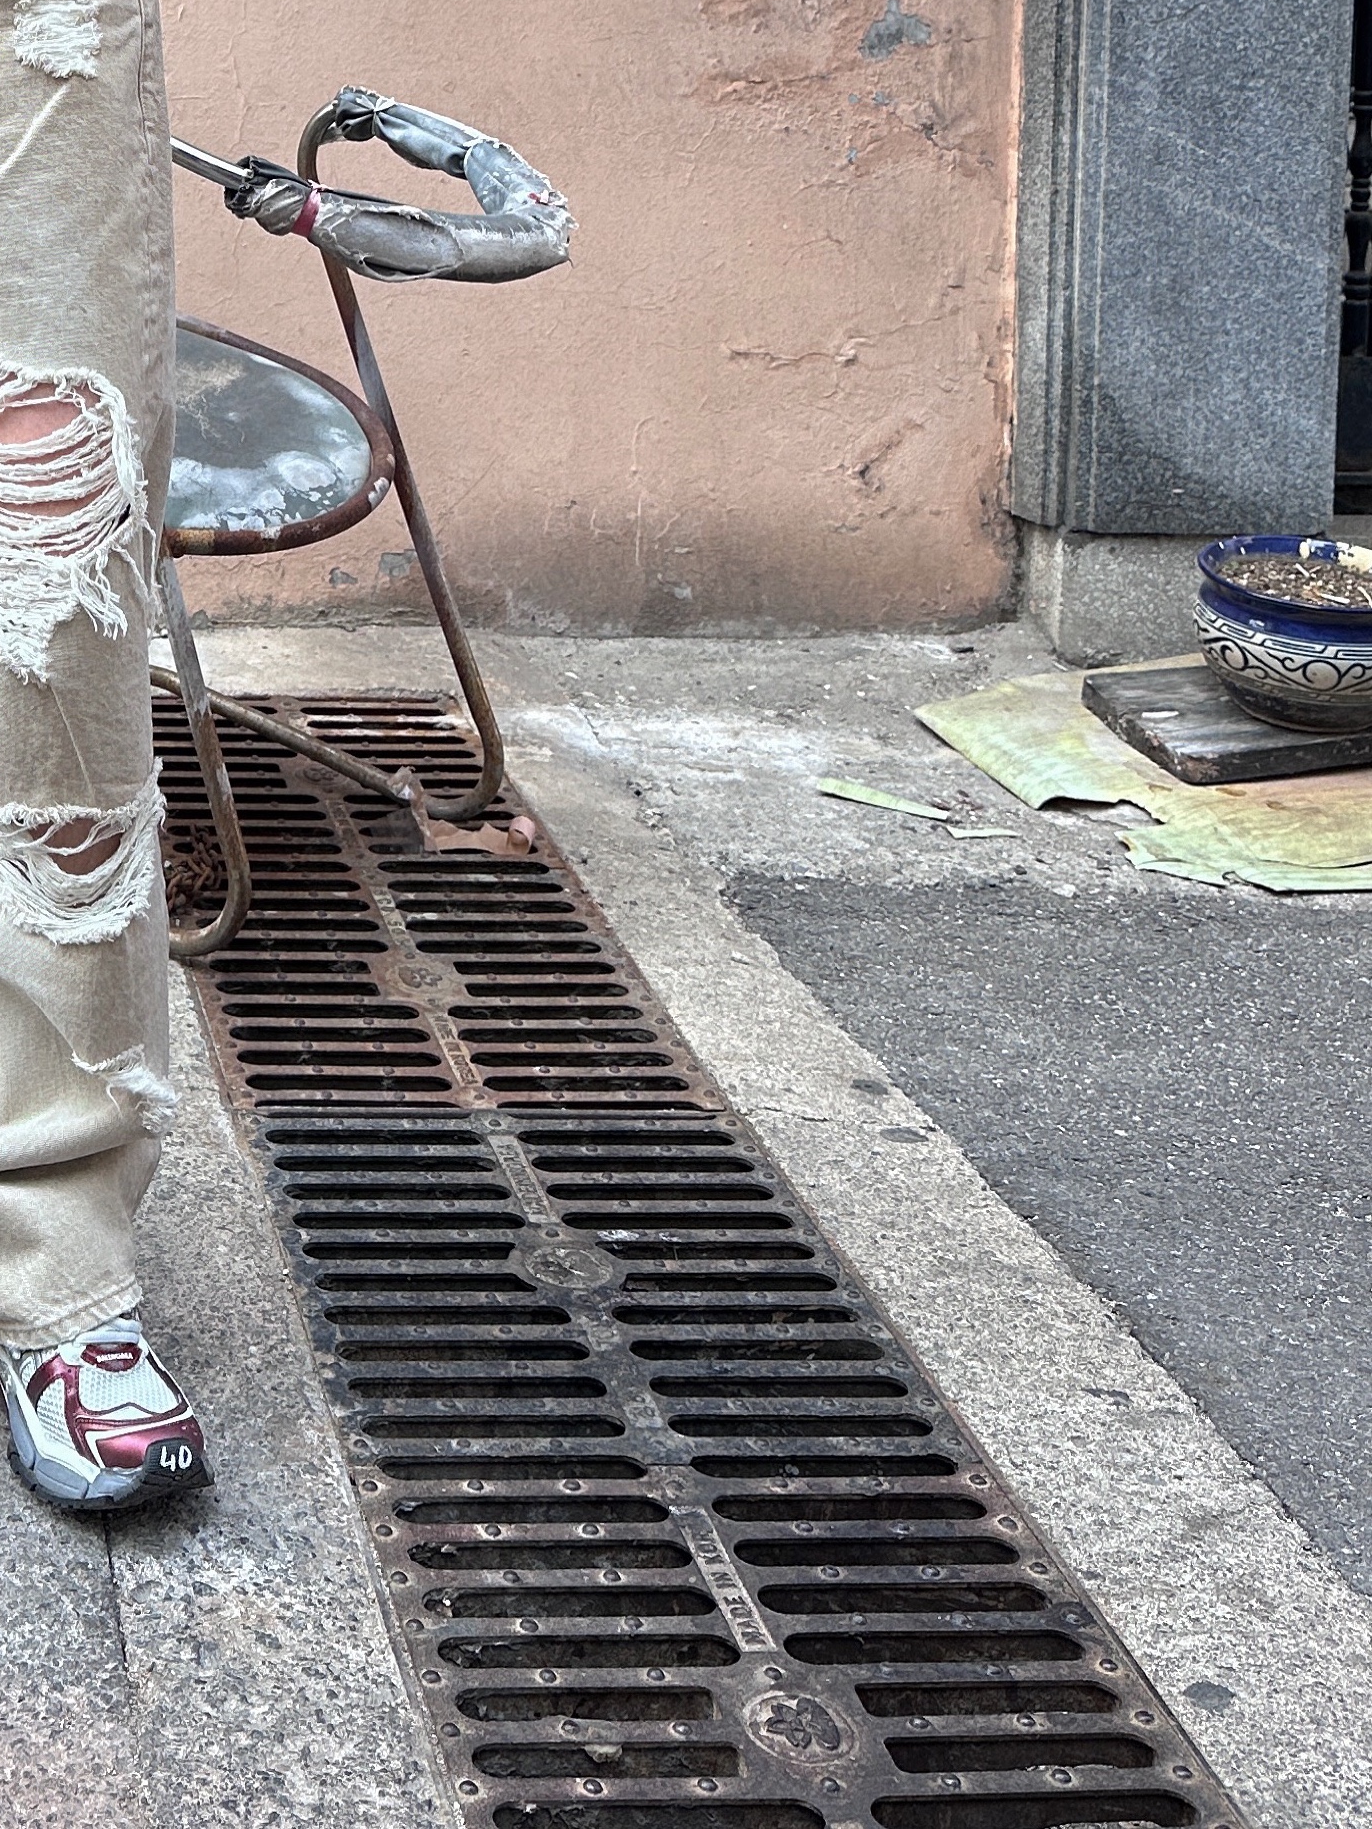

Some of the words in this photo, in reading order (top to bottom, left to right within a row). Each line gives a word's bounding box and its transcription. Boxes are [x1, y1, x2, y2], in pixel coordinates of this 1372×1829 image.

[159, 1445, 193, 1472] 40
[709, 1572, 739, 1589] IN
[722, 1595, 767, 1646] MADE
